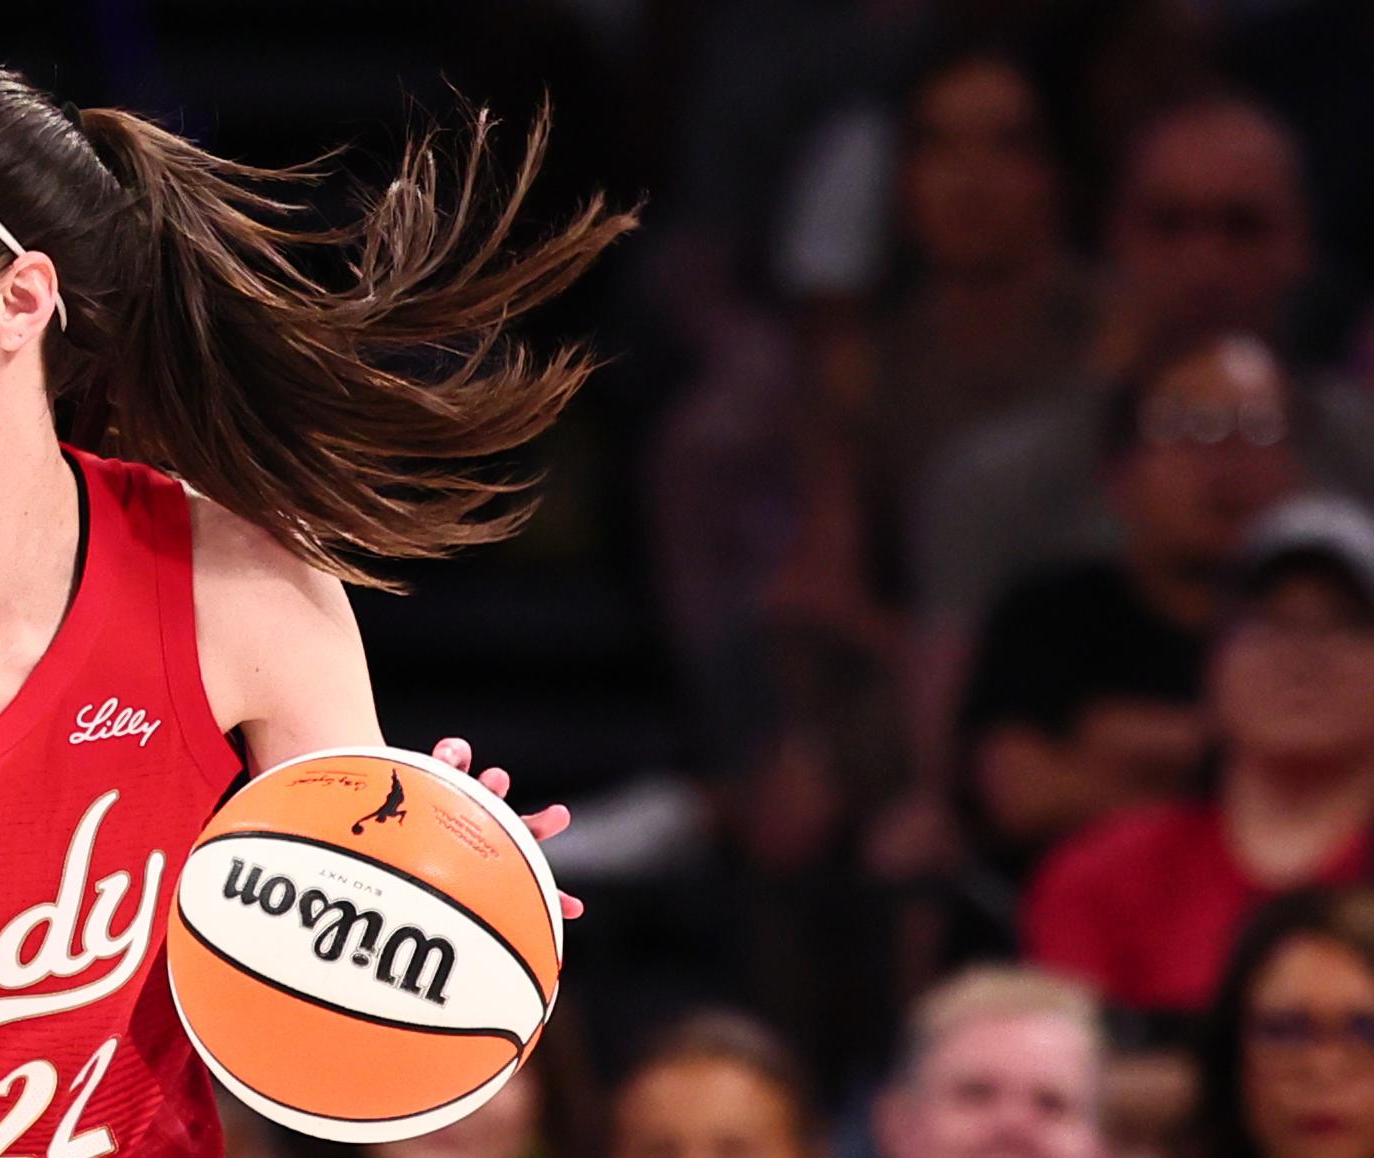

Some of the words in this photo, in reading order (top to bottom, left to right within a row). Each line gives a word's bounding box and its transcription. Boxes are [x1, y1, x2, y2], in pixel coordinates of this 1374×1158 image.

[69, 697, 162, 747] Lilly
[318, 868, 348, 884] NXT
[353, 881, 383, 897] EVO
[222, 856, 458, 1008] Wilson
